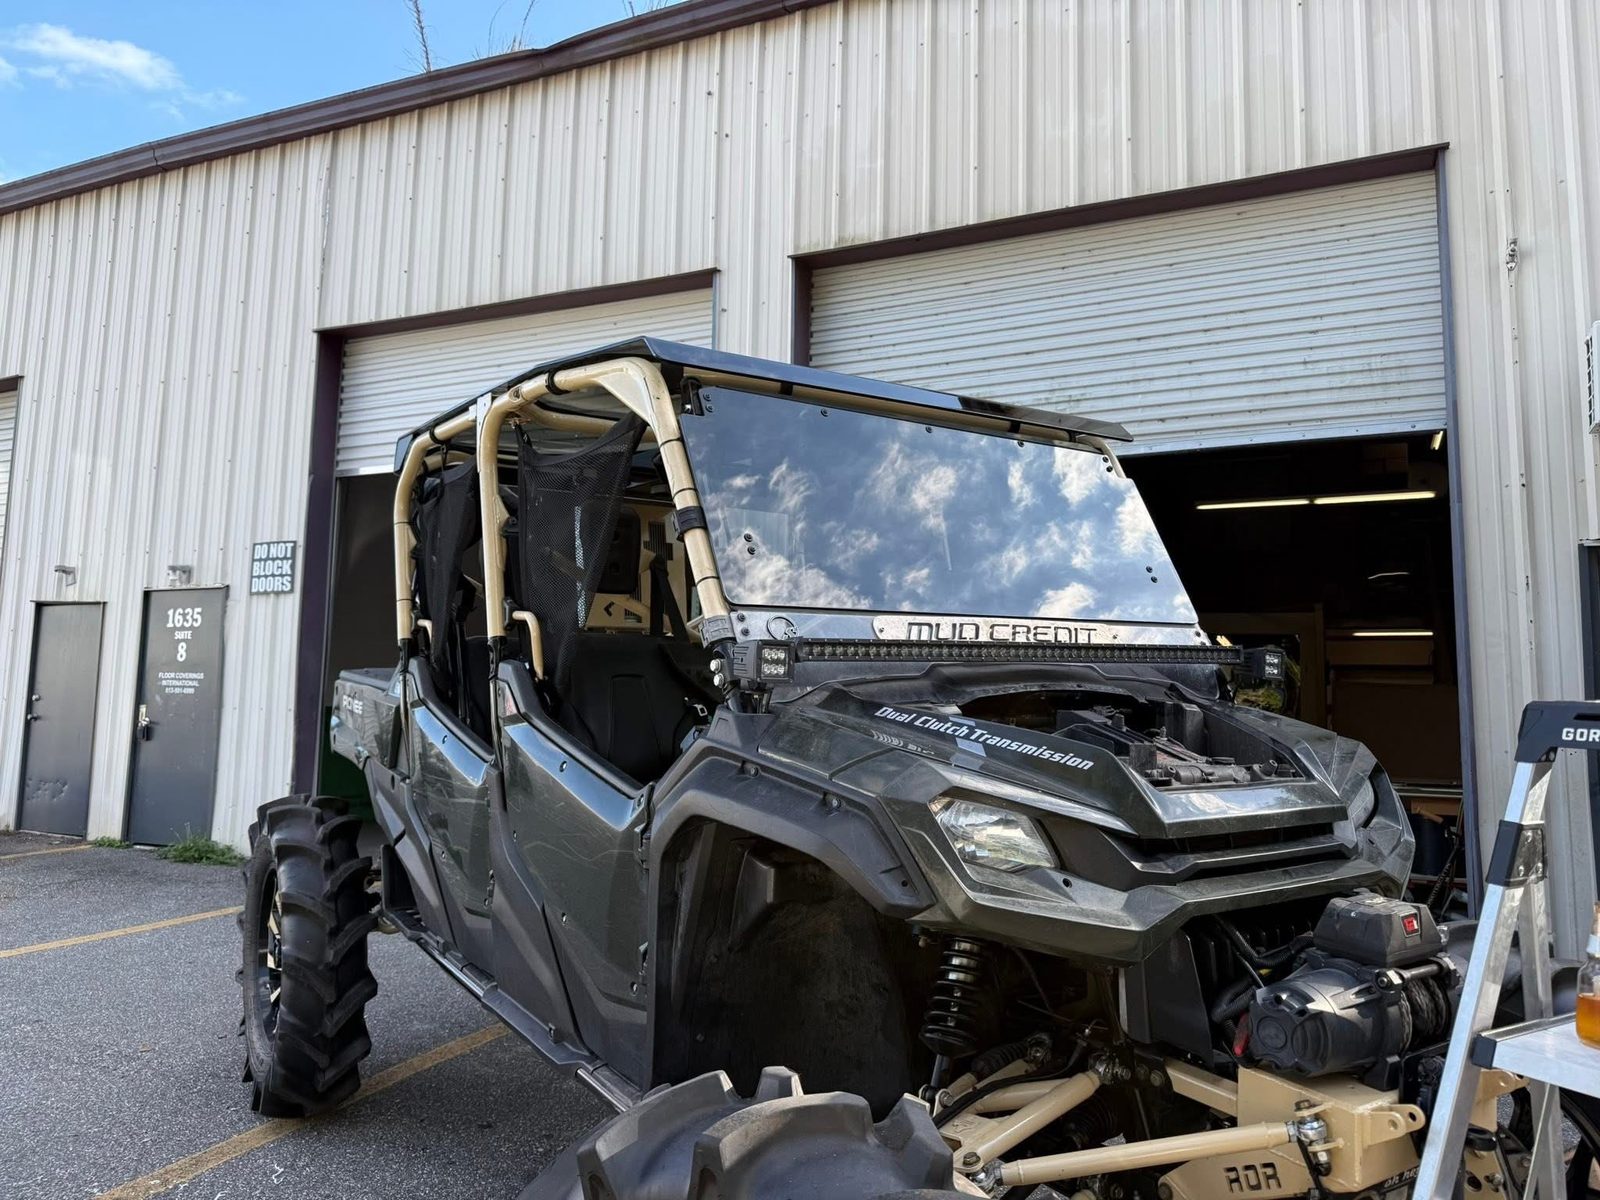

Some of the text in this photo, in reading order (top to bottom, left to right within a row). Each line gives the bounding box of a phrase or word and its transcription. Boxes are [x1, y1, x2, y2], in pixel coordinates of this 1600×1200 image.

[254, 542, 294, 559] DO NOT
[252, 559, 292, 576] BLOCK
[250, 576, 291, 592] DOORS
[166, 607, 202, 628] 1635
[174, 630, 193, 640] SUITE
[907, 621, 1098, 644] MUD CREDIT
[176, 642, 187, 662] 8
[158, 671, 204, 680] FLOOR COVERINGS
[161, 679, 200, 687] INTERNATIONAL
[874, 706, 1095, 771] Dual Clutch Transmission
[1561, 727, 1600, 742] GOR
